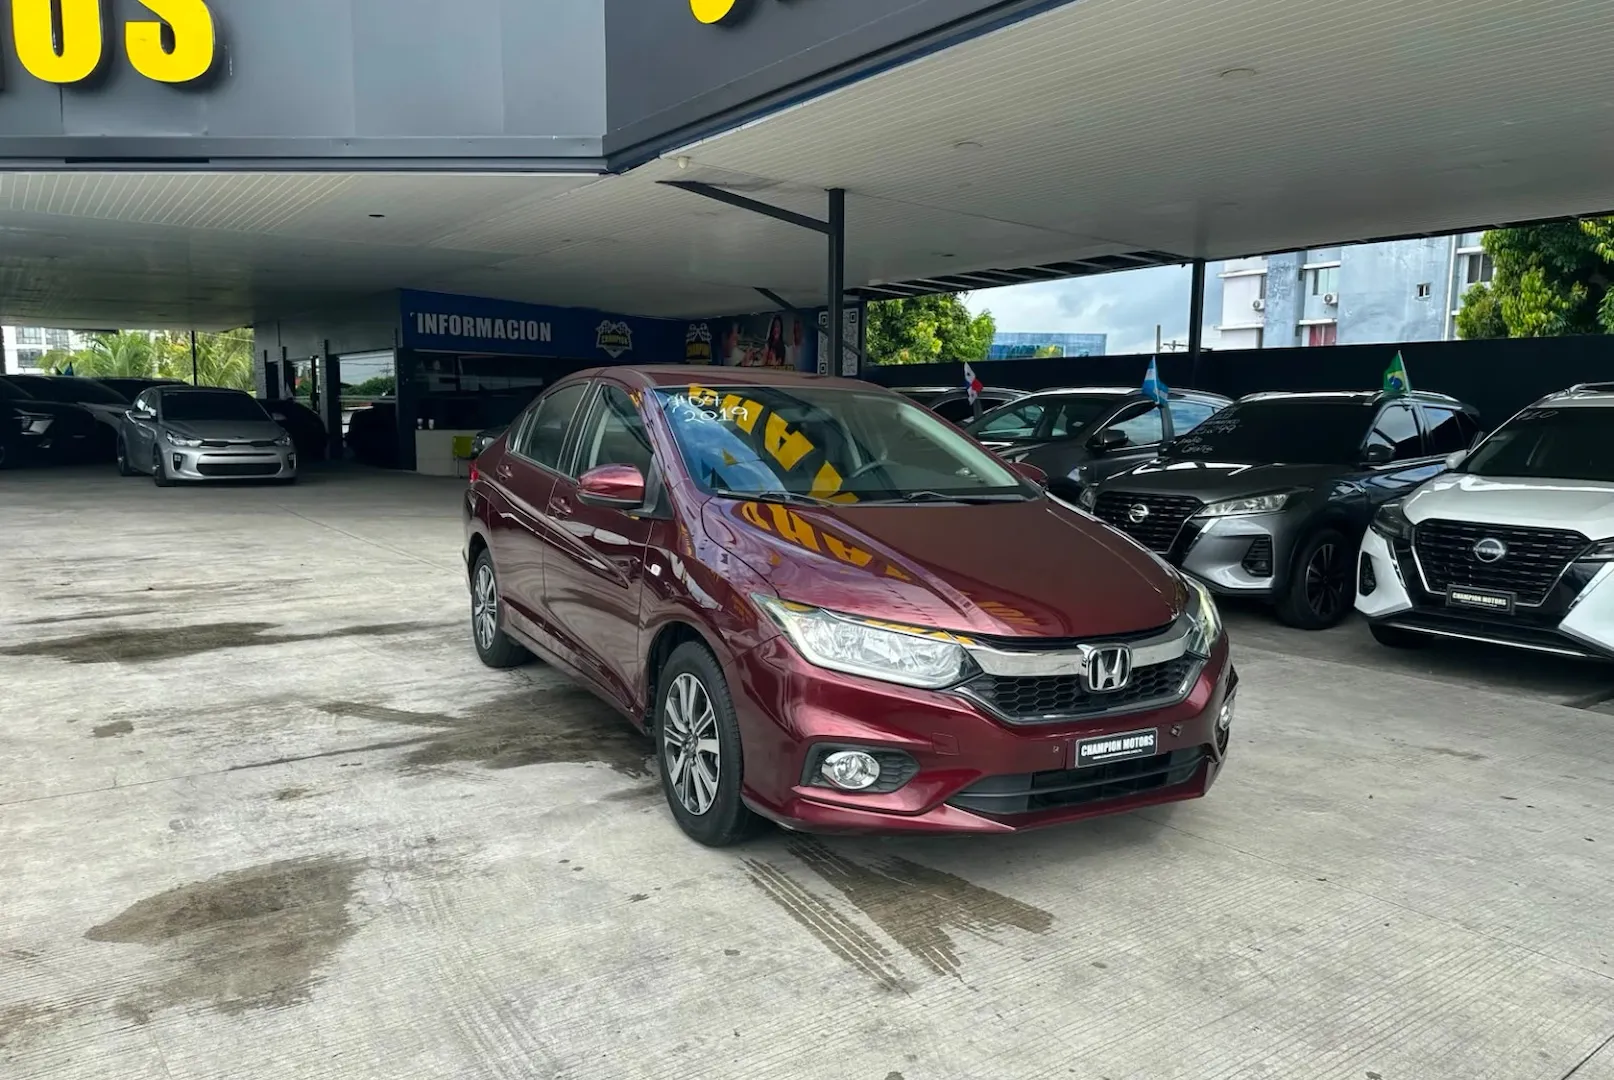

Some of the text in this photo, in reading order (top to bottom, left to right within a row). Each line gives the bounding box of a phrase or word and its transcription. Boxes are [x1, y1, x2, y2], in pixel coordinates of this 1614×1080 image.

[416, 312, 552, 342] INFORMACION
[683, 406, 749, 424] 2019
[1452, 592, 1482, 603] CHAMPION
[1482, 596, 1507, 606] MOTORS
[1081, 740, 1122, 757] CHAMPION
[1122, 735, 1155, 750] MOTORS
